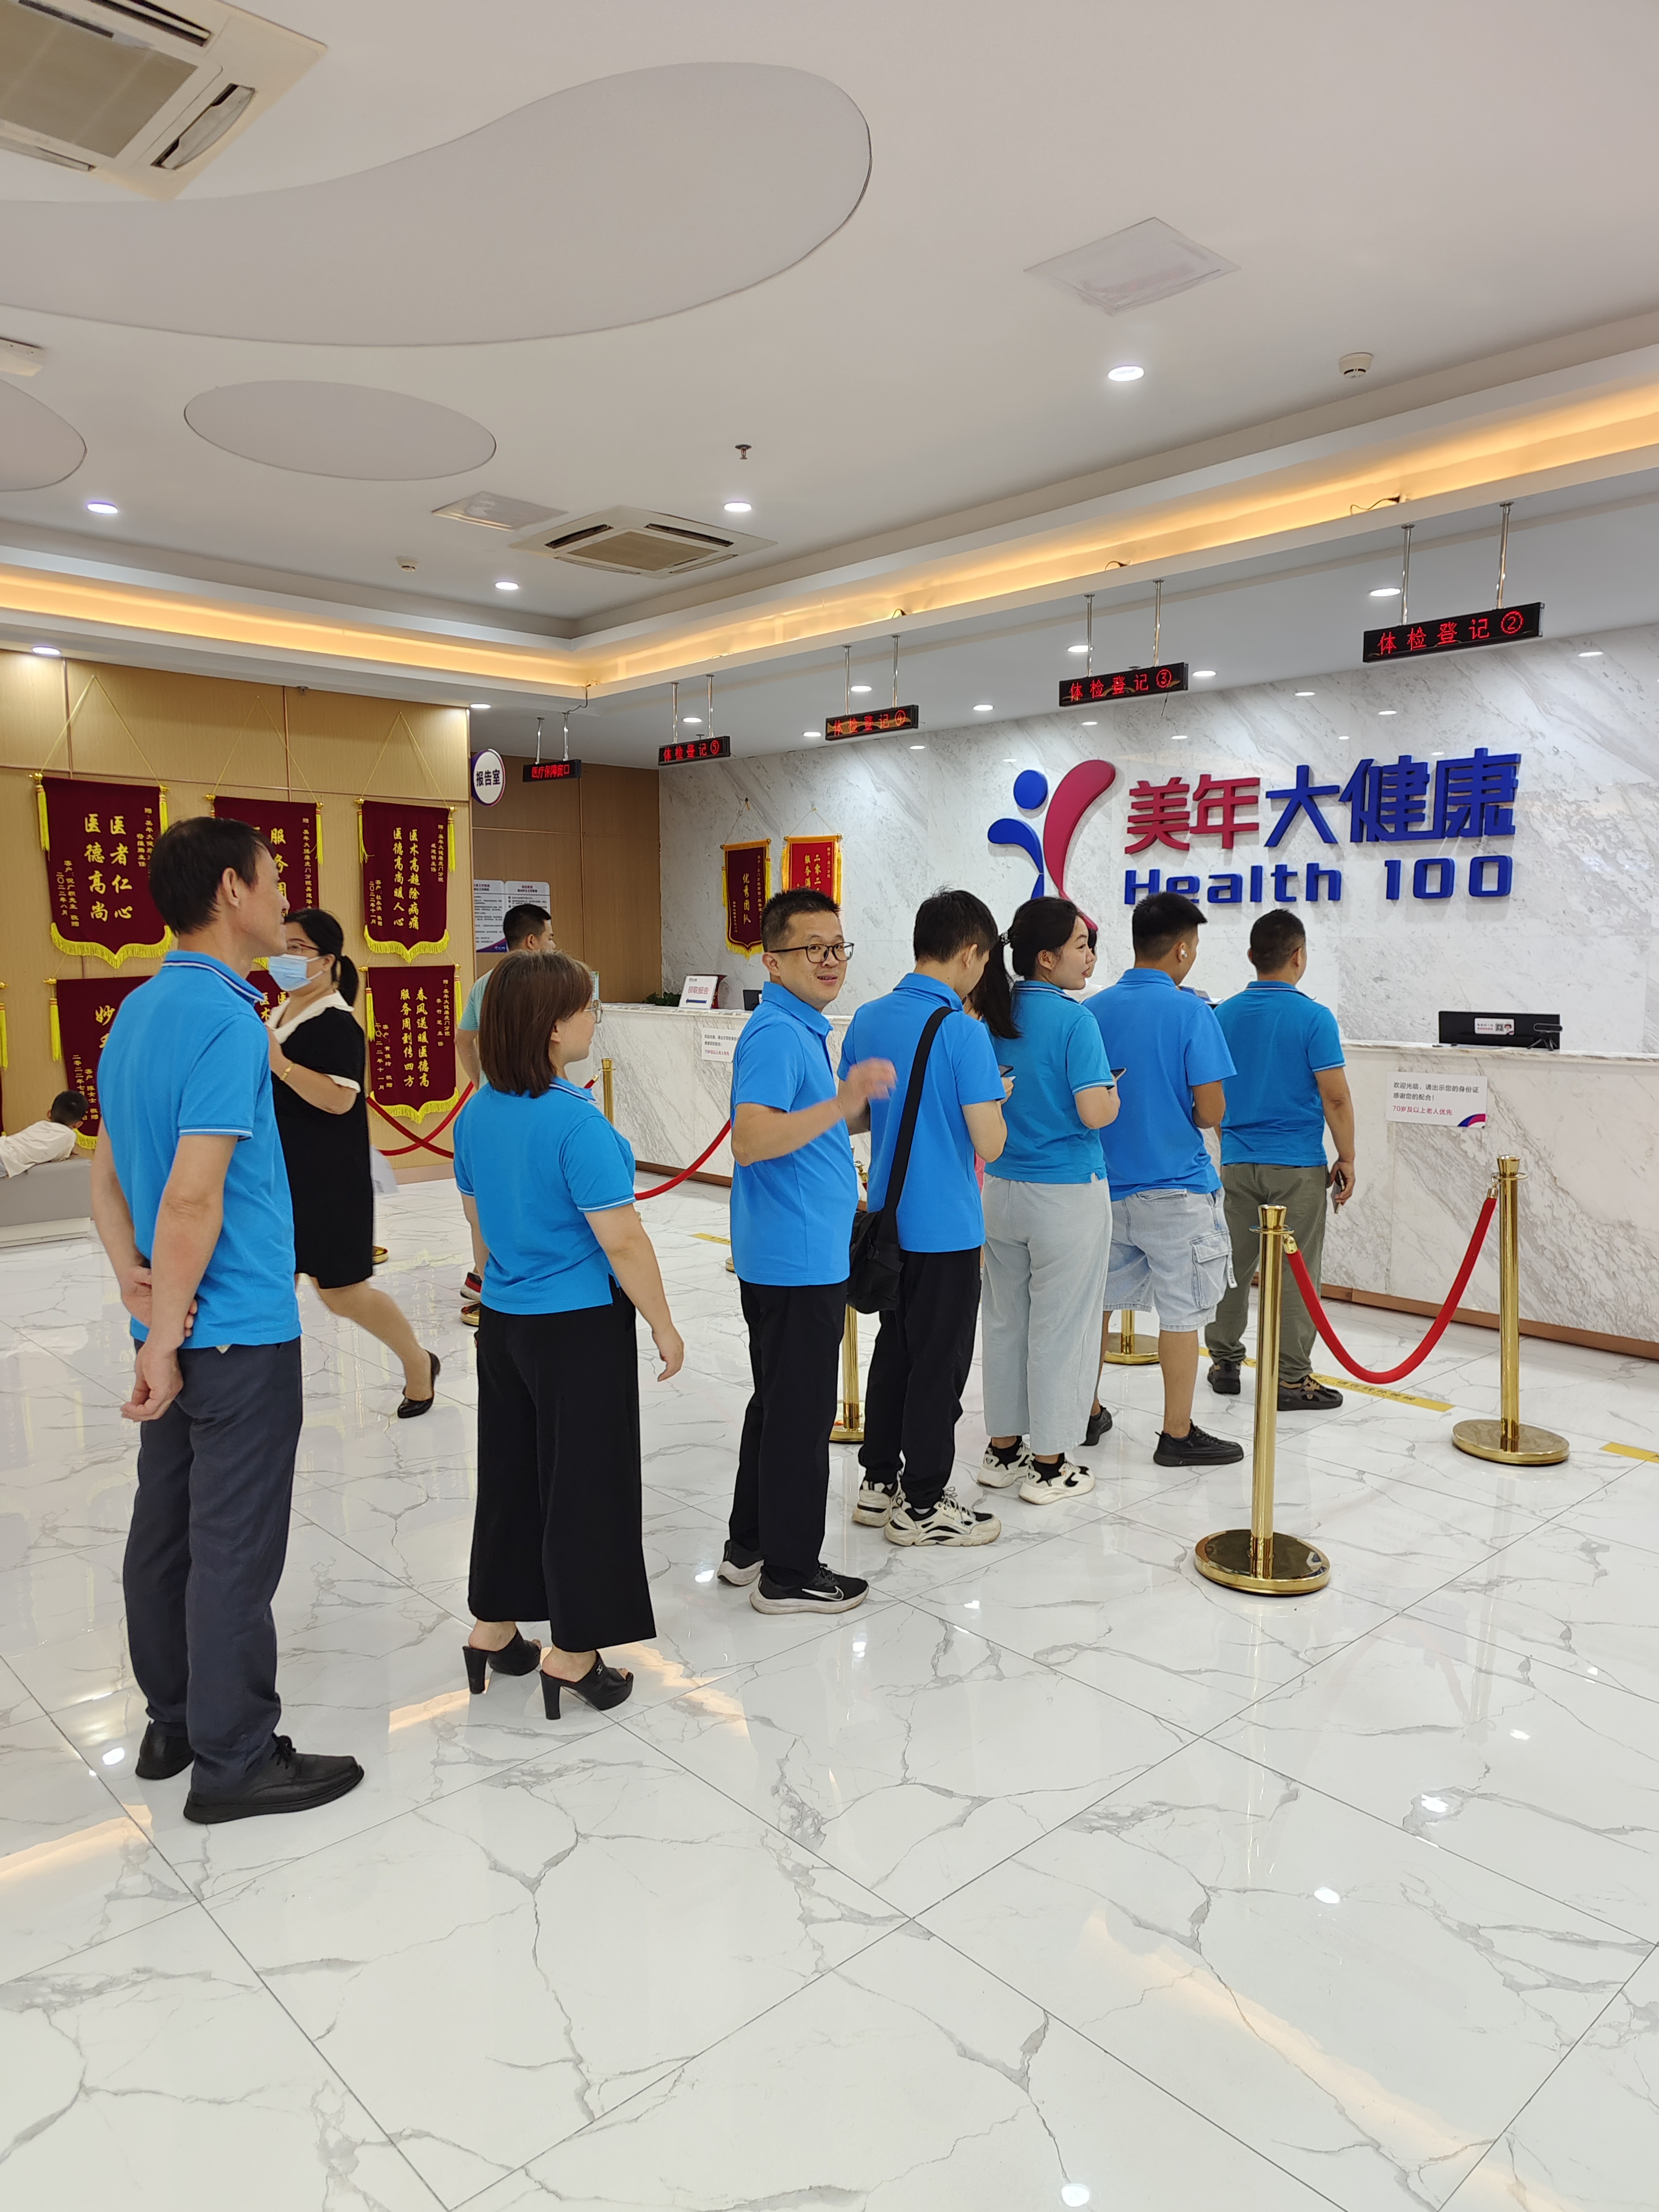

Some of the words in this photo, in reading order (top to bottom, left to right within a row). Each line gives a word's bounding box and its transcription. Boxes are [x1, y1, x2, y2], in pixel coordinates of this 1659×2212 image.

[477, 769, 500, 787] 报告室
[1124, 748, 1521, 854] 美年大健康
[85, 813, 108, 922] 医德高尚
[110, 815, 133, 919] 医者仁心
[271, 828, 289, 917] 服务周
[393, 827, 405, 927] 医德高尚暖人心
[407, 828, 421, 930] 医术高超除病痛
[742, 873, 751, 925] 优秀团队
[1124, 863, 1342, 904] Health
[1385, 855, 1513, 899] 100
[400, 988, 414, 1088] 服务周到传四方
[415, 987, 429, 1088] 春风送暖医德高
[1392, 1105, 1453, 1116] 70岁及以上老人优先
[1393, 1082, 1480, 1094] 欢迎光临，请出示您的身份证
